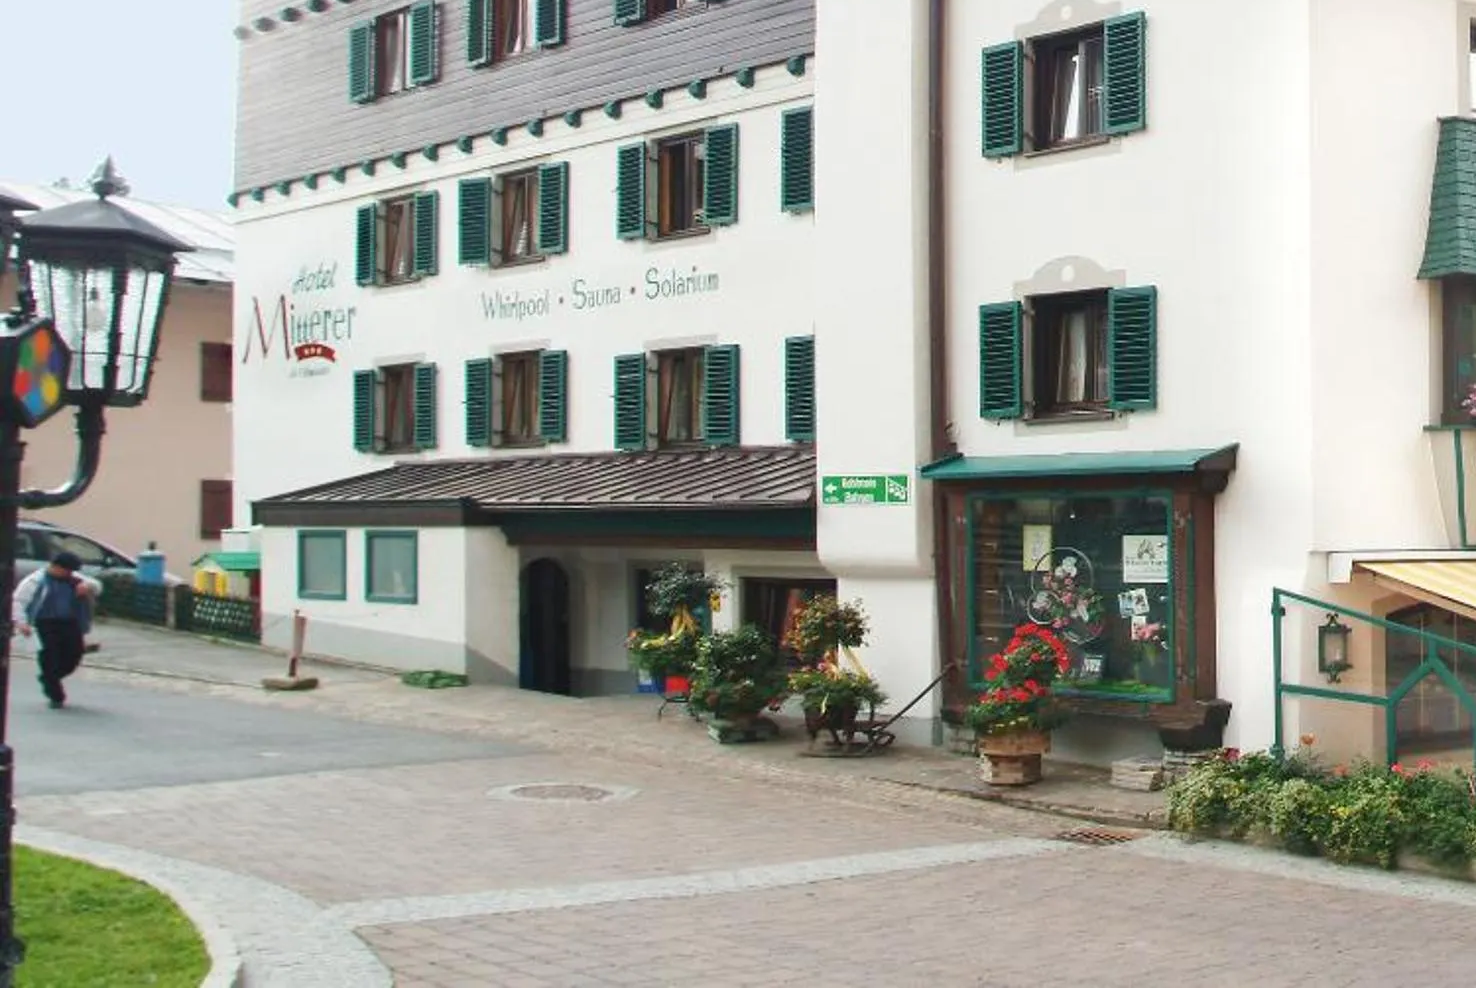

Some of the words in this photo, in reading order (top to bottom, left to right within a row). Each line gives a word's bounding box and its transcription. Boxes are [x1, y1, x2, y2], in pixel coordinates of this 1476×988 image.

[291, 261, 338, 293] Hotel
[481, 289, 550, 321] Whirlpool
[572, 278, 621, 310] Sauna
[645, 266, 719, 300] Solarium
